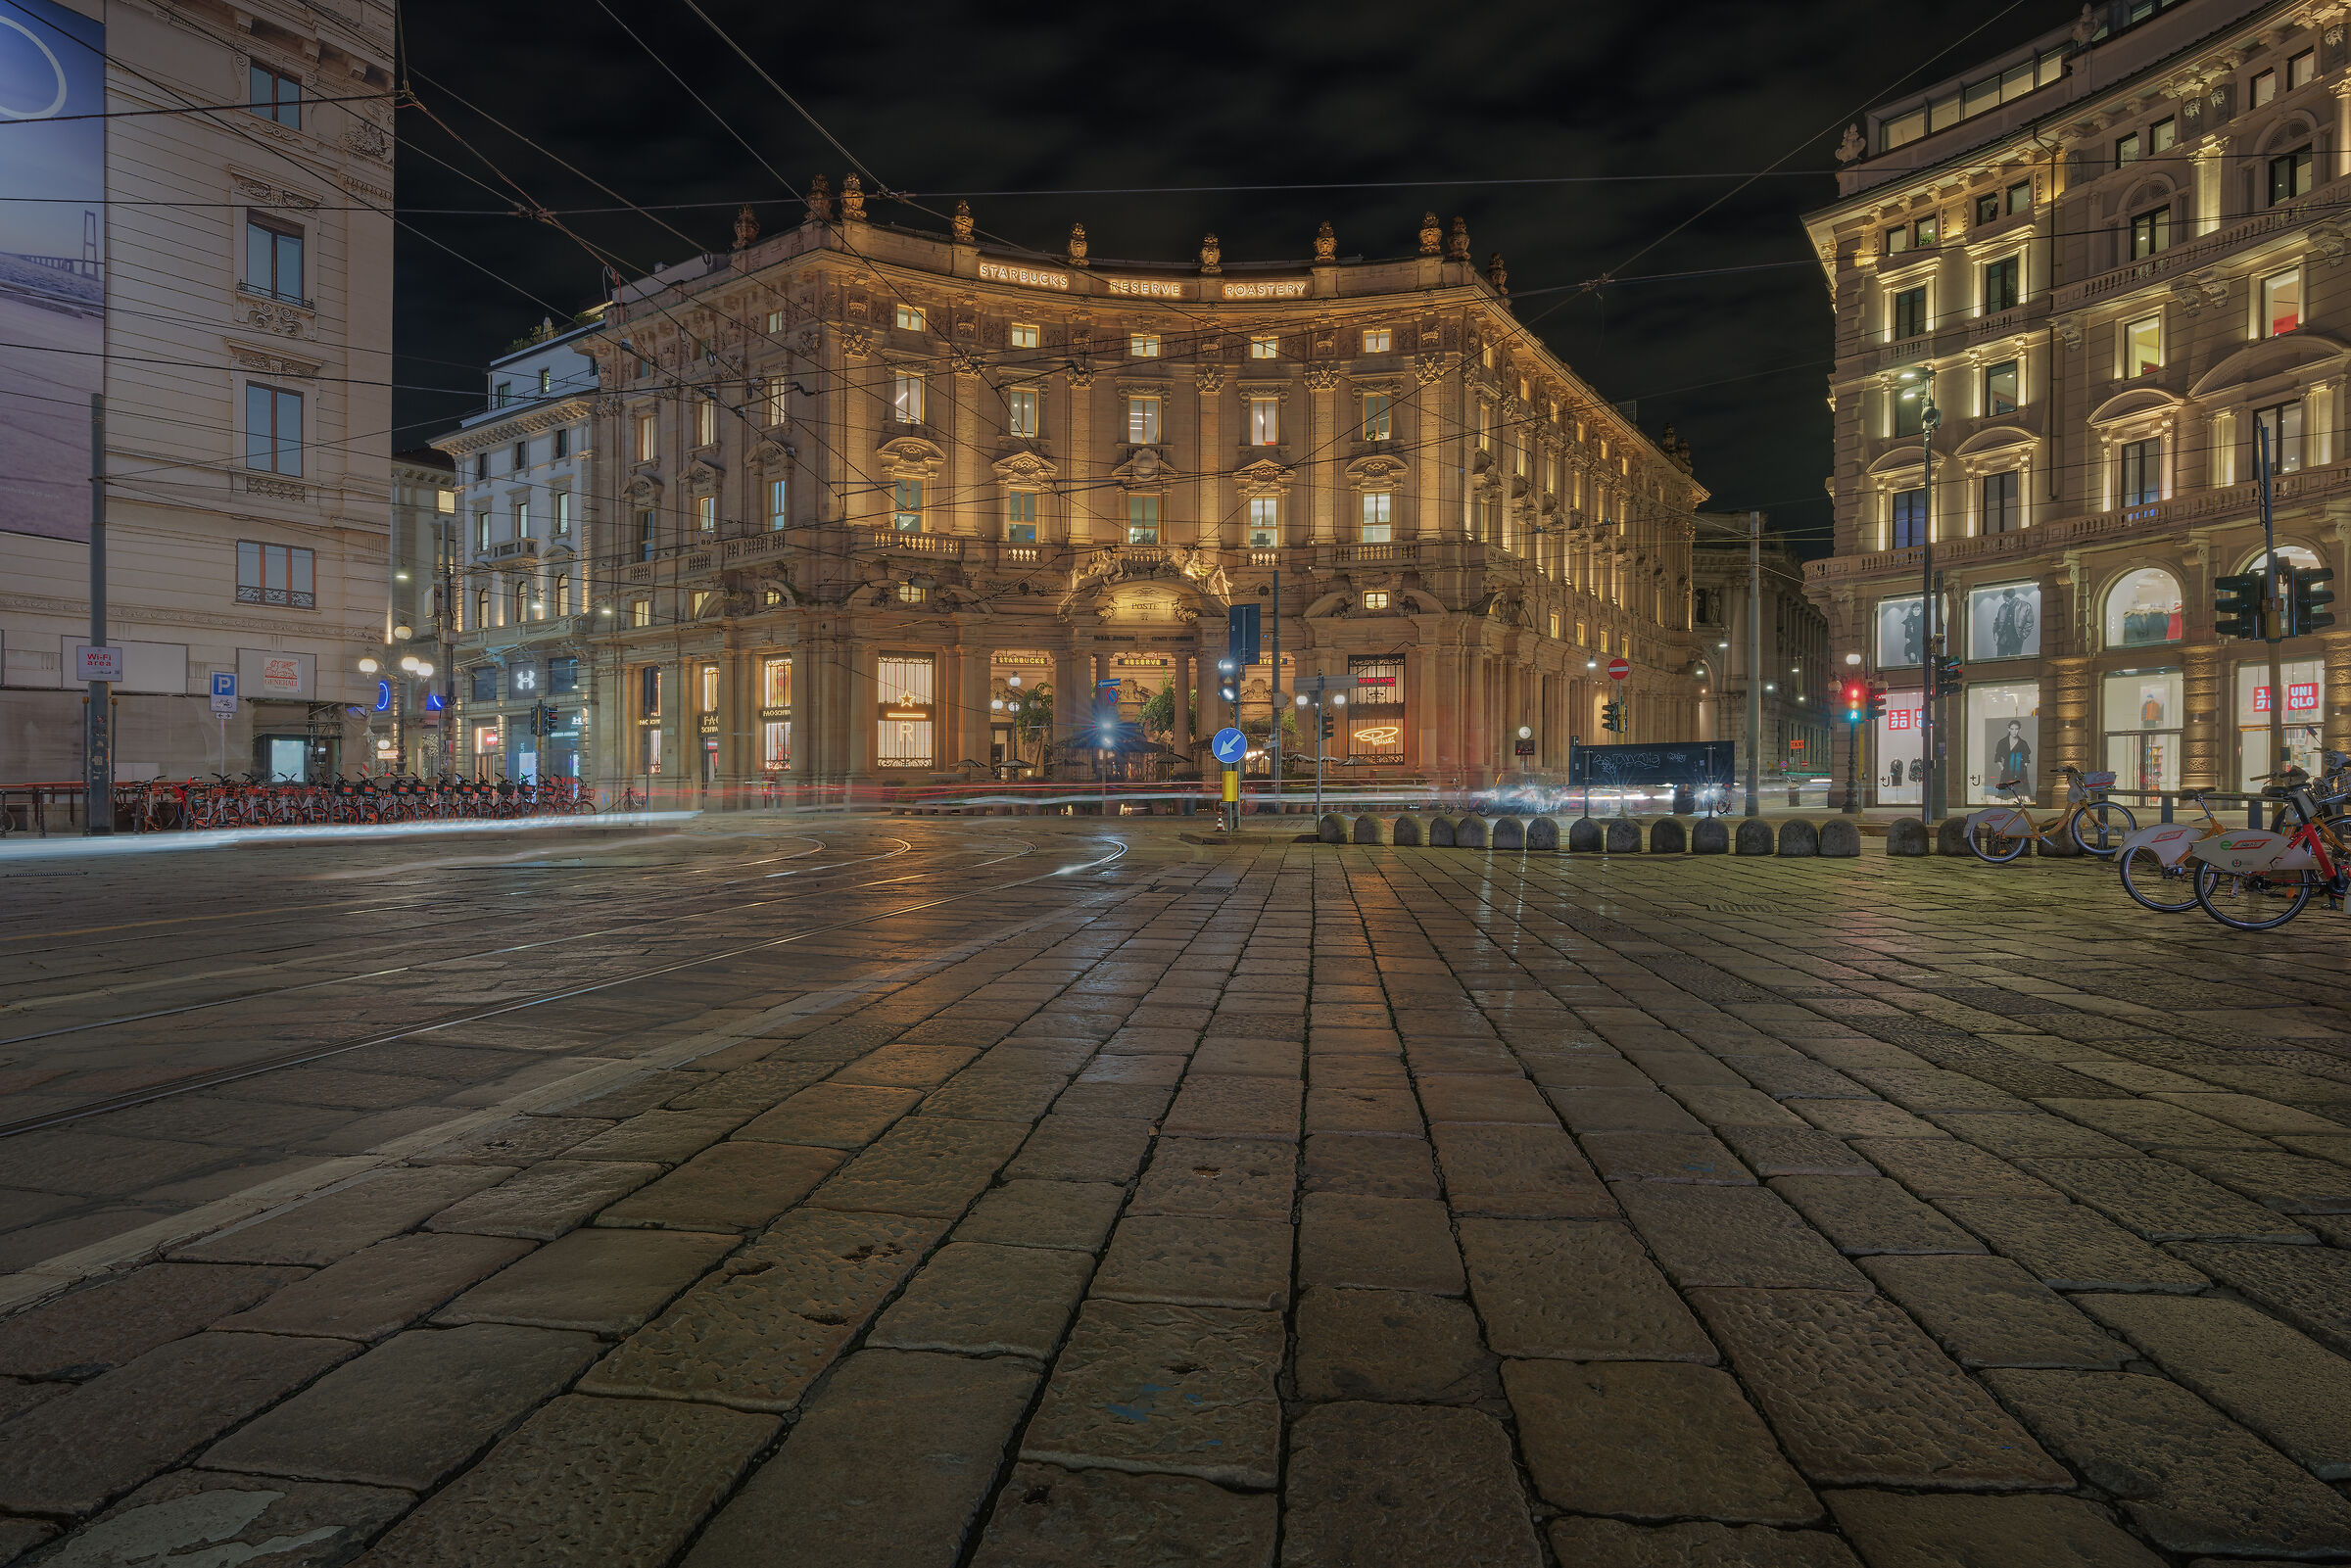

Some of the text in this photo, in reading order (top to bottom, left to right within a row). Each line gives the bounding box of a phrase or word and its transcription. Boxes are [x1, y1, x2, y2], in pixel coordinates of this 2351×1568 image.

[982, 265, 1305, 296] STARBUCKS RESERVE ROASTERY
[218, 677, 231, 691] P
[2290, 686, 2312, 696] UNI
[2290, 696, 2314, 709] QLO
[899, 723, 913, 743] R
